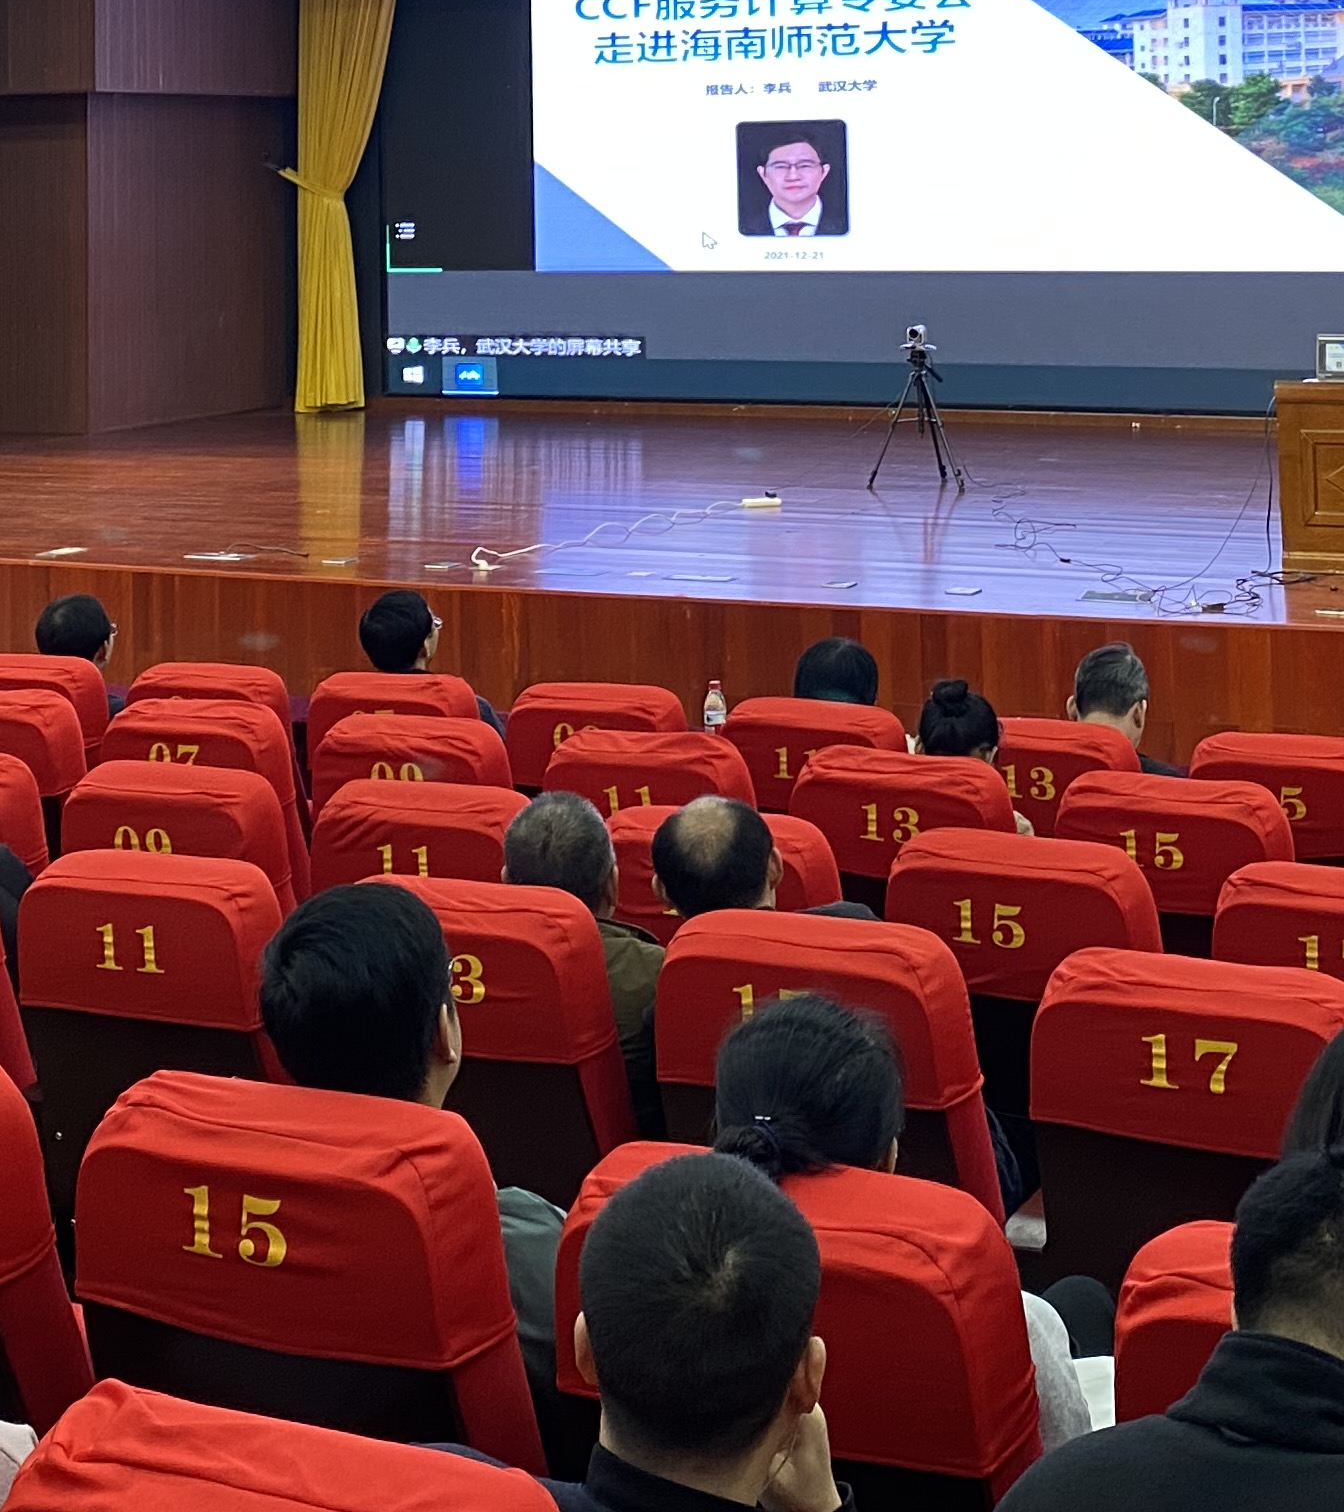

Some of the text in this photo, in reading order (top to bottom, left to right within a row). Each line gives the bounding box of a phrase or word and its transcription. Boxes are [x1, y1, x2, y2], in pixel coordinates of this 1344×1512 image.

[593, 19, 957, 65] 走进海南师范大学
[817, 79, 878, 93] 武汉大学
[763, 251, 824, 260] 2021-12-21
[1001, 763, 1056, 801] 13
[1280, 786, 1307, 820] 5
[859, 802, 920, 845] 13
[376, 843, 429, 879] 11
[1120, 829, 1184, 871] 15
[952, 898, 1026, 949] 15
[95, 922, 165, 975] 11
[453, 953, 486, 1004] 3
[1140, 1033, 1239, 1094] 17
[182, 1184, 288, 1268] 15
